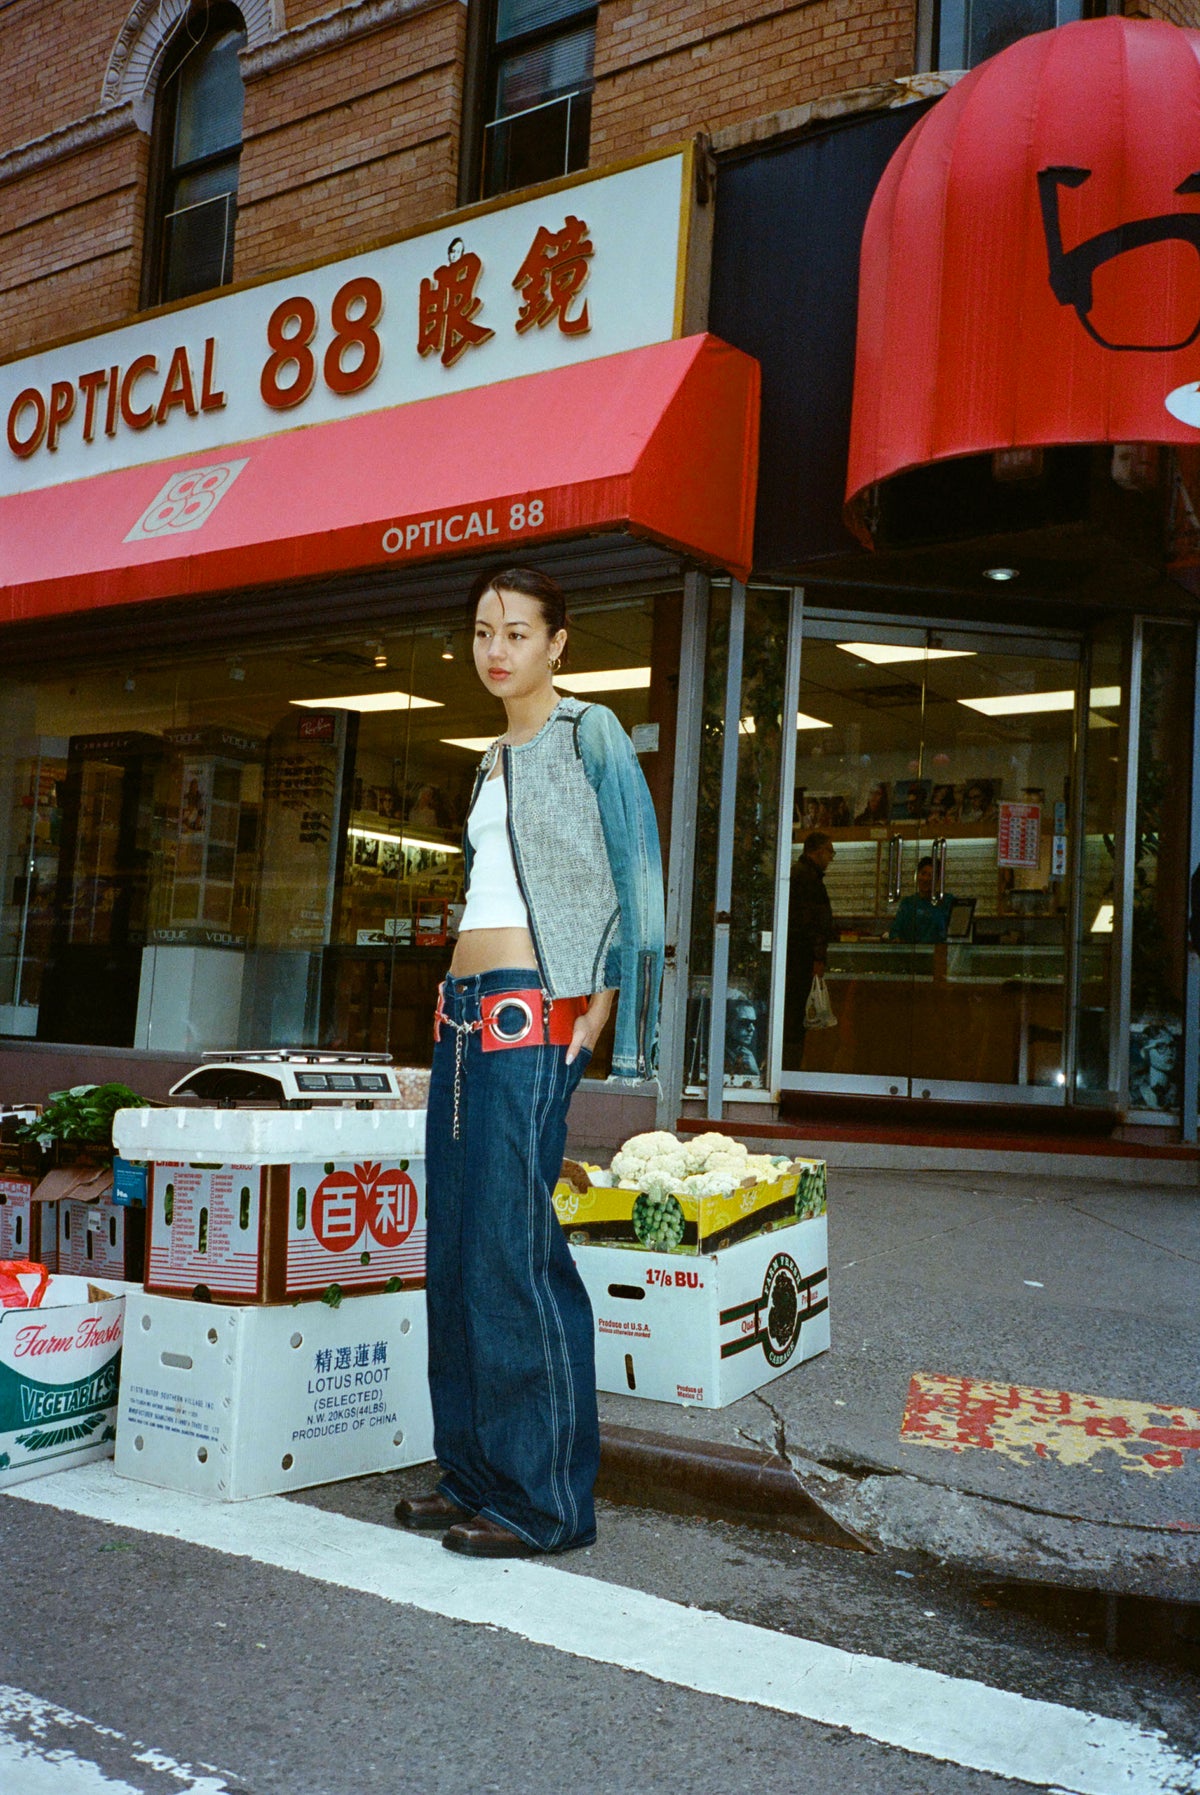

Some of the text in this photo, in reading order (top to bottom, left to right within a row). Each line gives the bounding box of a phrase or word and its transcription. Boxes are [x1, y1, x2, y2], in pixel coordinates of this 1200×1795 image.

[417, 214, 595, 367] 眼鏡
[7, 277, 385, 458] OPTICAL 88
[382, 500, 545, 554] OPTICAL 88
[322, 1184, 411, 1238] 百利
[675, 1271, 704, 1288] BU.
[764, 1256, 802, 1294] FARM FRESH
[14, 1313, 122, 1358] Farm Fresh
[598, 1318, 651, 1332] Produce of U.S.A.
[20, 1364, 116, 1422] VEGETABLES
[307, 1367, 391, 1394] LOTUS ROOT
[676, 1385, 697, 1394] Produce
[306, 1402, 387, 1426] N.W. 20KGS(44LBS)
[314, 1389, 383, 1412] (SELECTED)
[292, 1413, 398, 1442] PRODUCED OF CHINA
